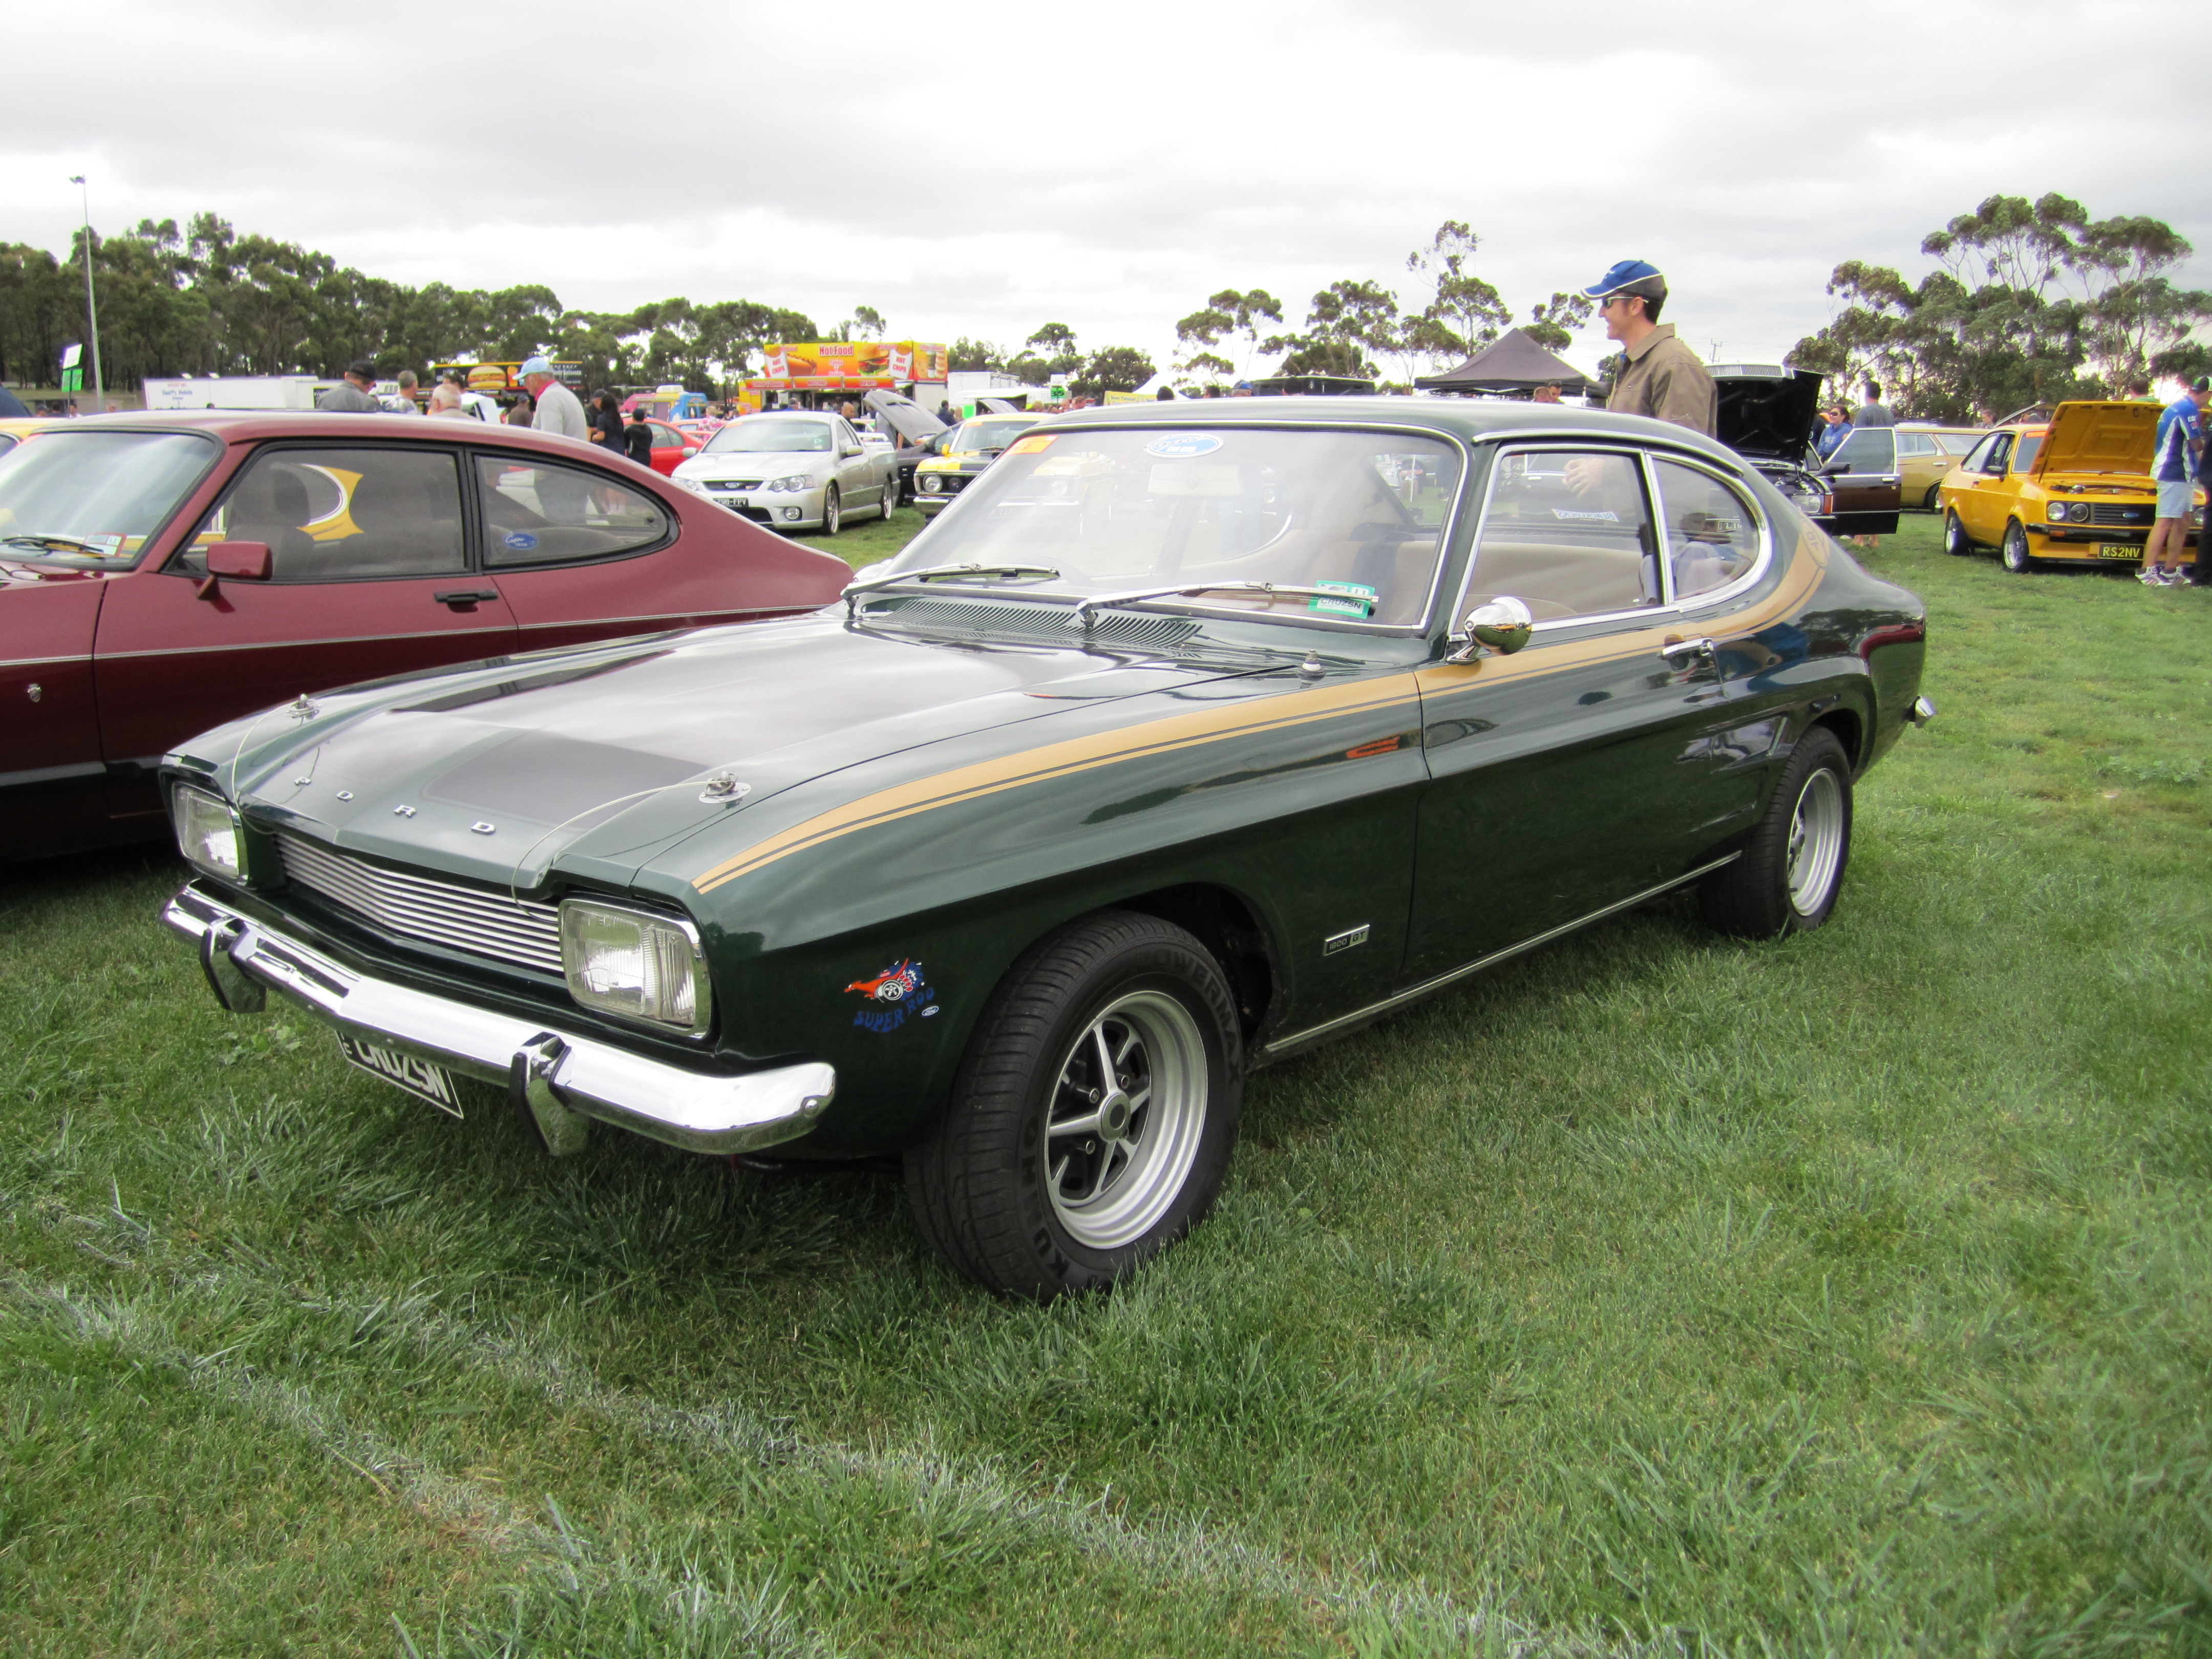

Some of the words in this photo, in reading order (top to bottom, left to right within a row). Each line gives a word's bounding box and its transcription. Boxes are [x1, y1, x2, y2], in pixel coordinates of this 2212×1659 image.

[819, 345, 833, 355] Hot
[834, 345, 854, 355] Food
[2102, 546, 2140, 558] RS2NV
[1321, 598, 1362, 609] CRUZSN
[1329, 938, 1348, 950] 1600
[1352, 931, 1366, 942] GT
[854, 1009, 905, 1032] SUPER
[907, 987, 934, 1014] ROO
